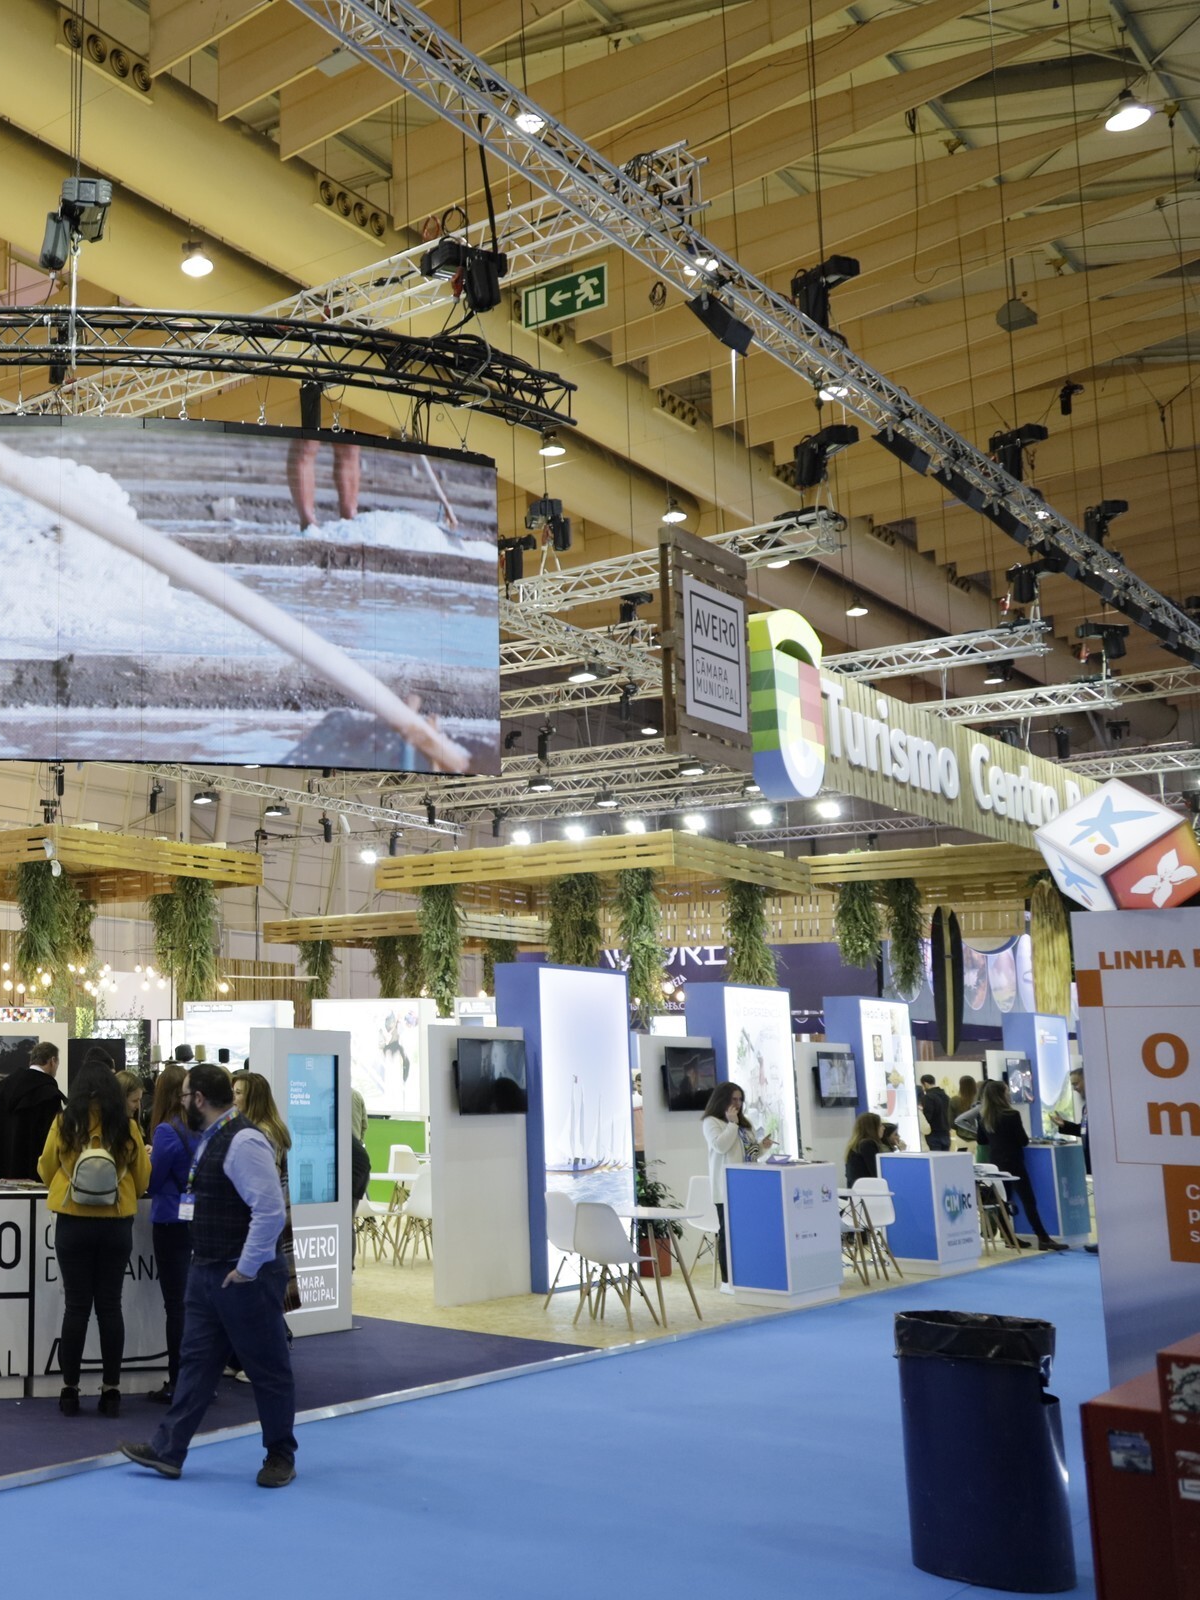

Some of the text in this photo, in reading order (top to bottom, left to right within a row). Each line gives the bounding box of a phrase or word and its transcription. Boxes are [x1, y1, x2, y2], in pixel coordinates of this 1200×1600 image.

[695, 608, 736, 648] AVEIRO
[696, 677, 738, 705] MUNICIPAL
[820, 677, 960, 800] Turismo
[970, 743, 1059, 827] Centro
[1098, 948, 1185, 970] LINHA
[293, 1236, 335, 1260] AVEIRO
[300, 1288, 335, 1303] NICIPAL
